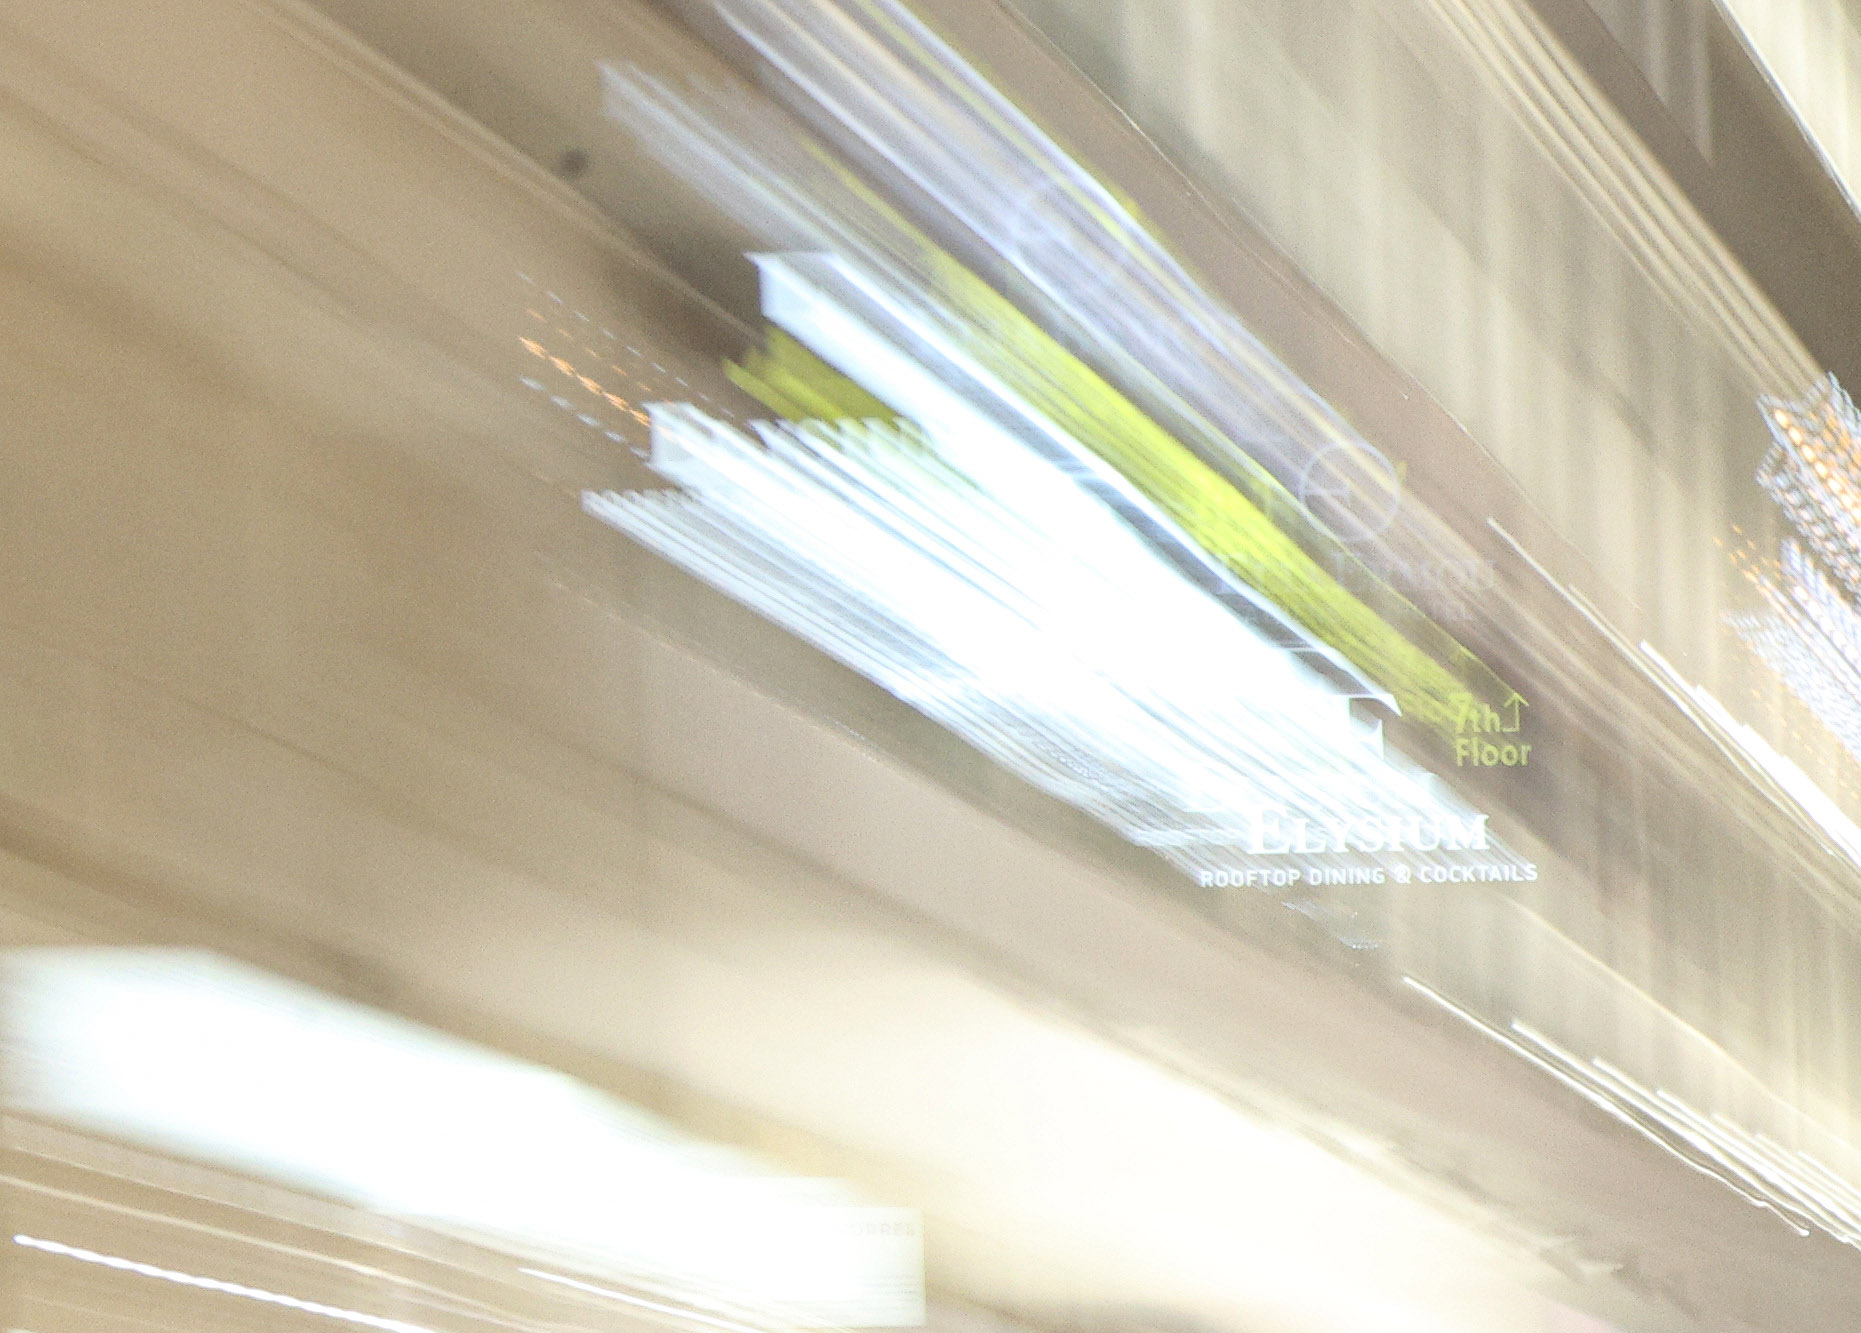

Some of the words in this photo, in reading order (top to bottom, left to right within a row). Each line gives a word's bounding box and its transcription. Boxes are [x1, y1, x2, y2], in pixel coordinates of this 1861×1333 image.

[1456, 736, 1531, 766] Floor
[1200, 868, 1301, 888] ROOFTOP
[1308, 866, 1386, 886] DINING
[1394, 864, 1412, 885] &
[1419, 863, 1539, 884] COCKTAILS
